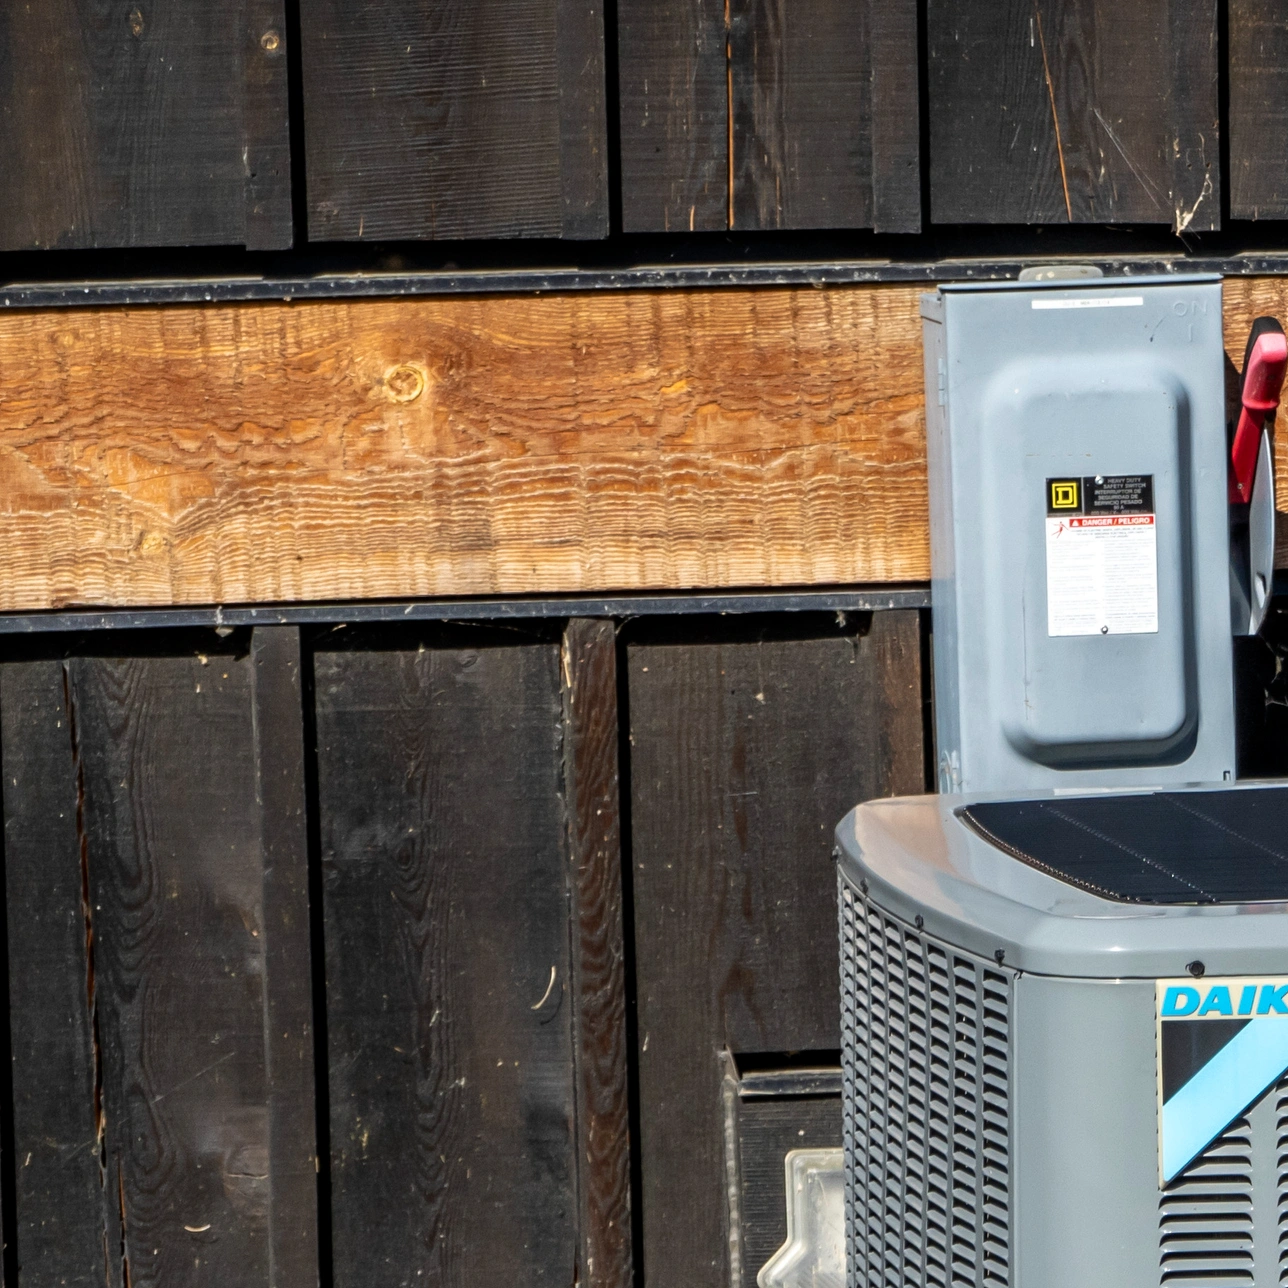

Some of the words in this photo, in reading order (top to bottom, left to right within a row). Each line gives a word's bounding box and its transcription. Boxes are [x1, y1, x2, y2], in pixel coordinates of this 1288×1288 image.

[1173, 300, 1207, 317] ON
[1082, 518, 1113, 526] DANGER
[1118, 517, 1150, 525] PELIGRO
